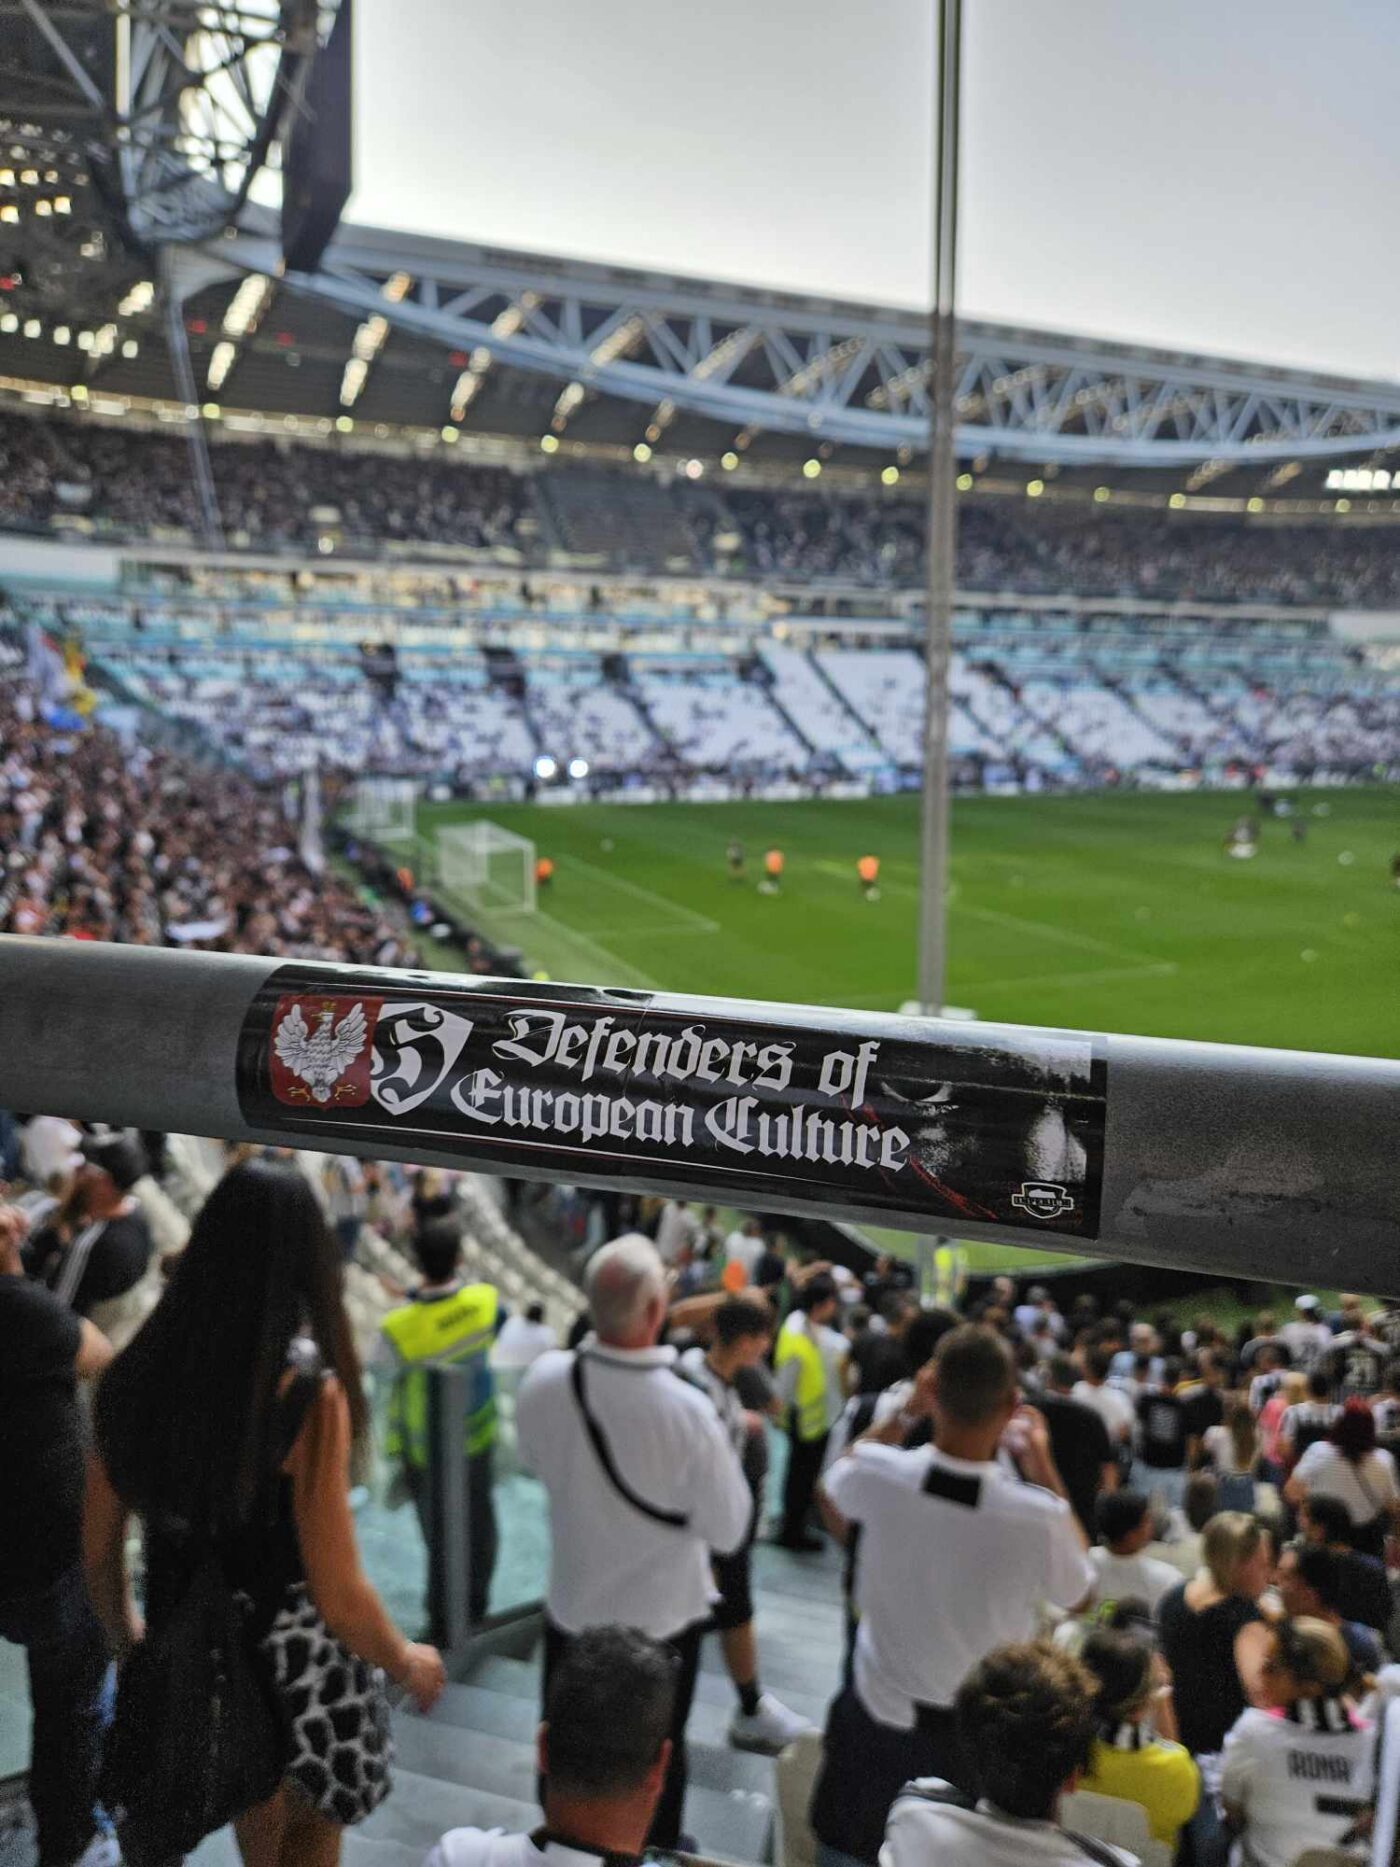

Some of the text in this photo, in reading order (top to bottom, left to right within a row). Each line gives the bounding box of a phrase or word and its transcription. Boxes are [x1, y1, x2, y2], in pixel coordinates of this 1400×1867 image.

[491, 1008, 881, 1109] Defenders of
[450, 1067, 911, 1173] European Culture
